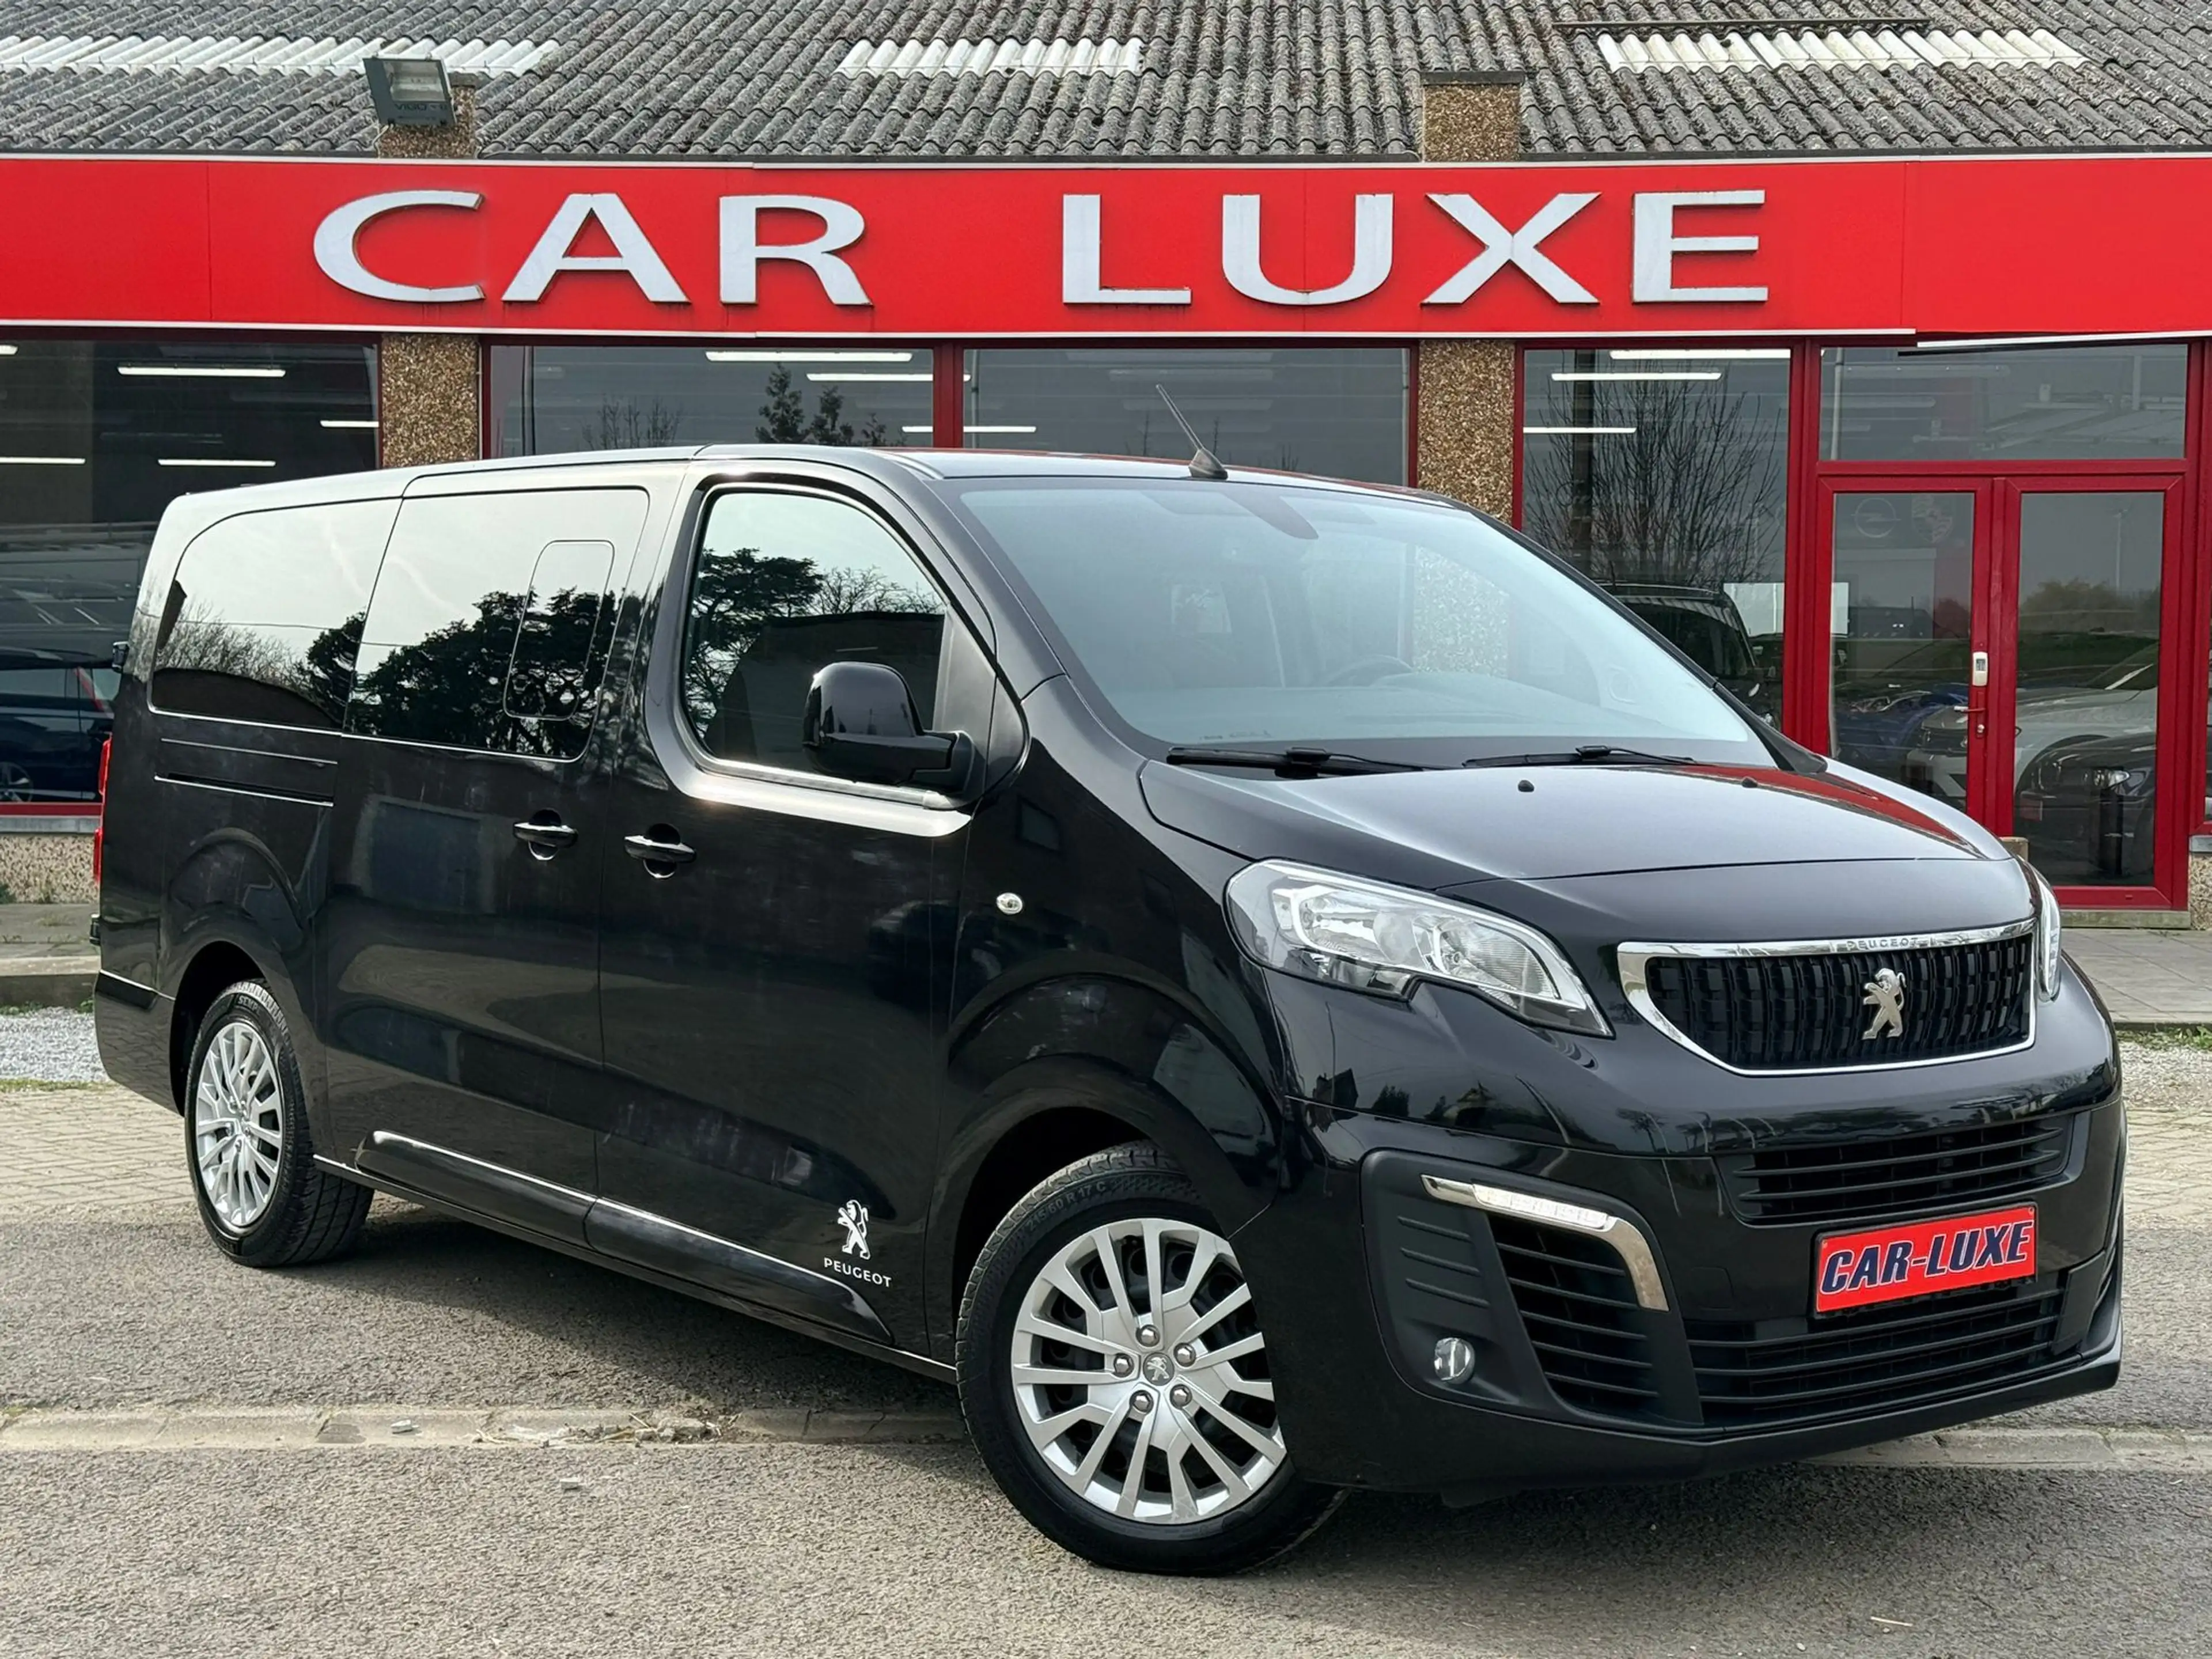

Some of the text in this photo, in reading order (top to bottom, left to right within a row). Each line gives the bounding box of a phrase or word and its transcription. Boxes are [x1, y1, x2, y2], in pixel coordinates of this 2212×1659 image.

[313, 190, 1768, 306] CAR LUXE
[1846, 937, 1918, 951] PEUGEOT
[1066, 1192, 1076, 1203] R
[1078, 1184, 1092, 1197] 17
[824, 1257, 892, 1288] PEUGEOT
[1820, 1219, 2035, 1295] CAR-LUXE
